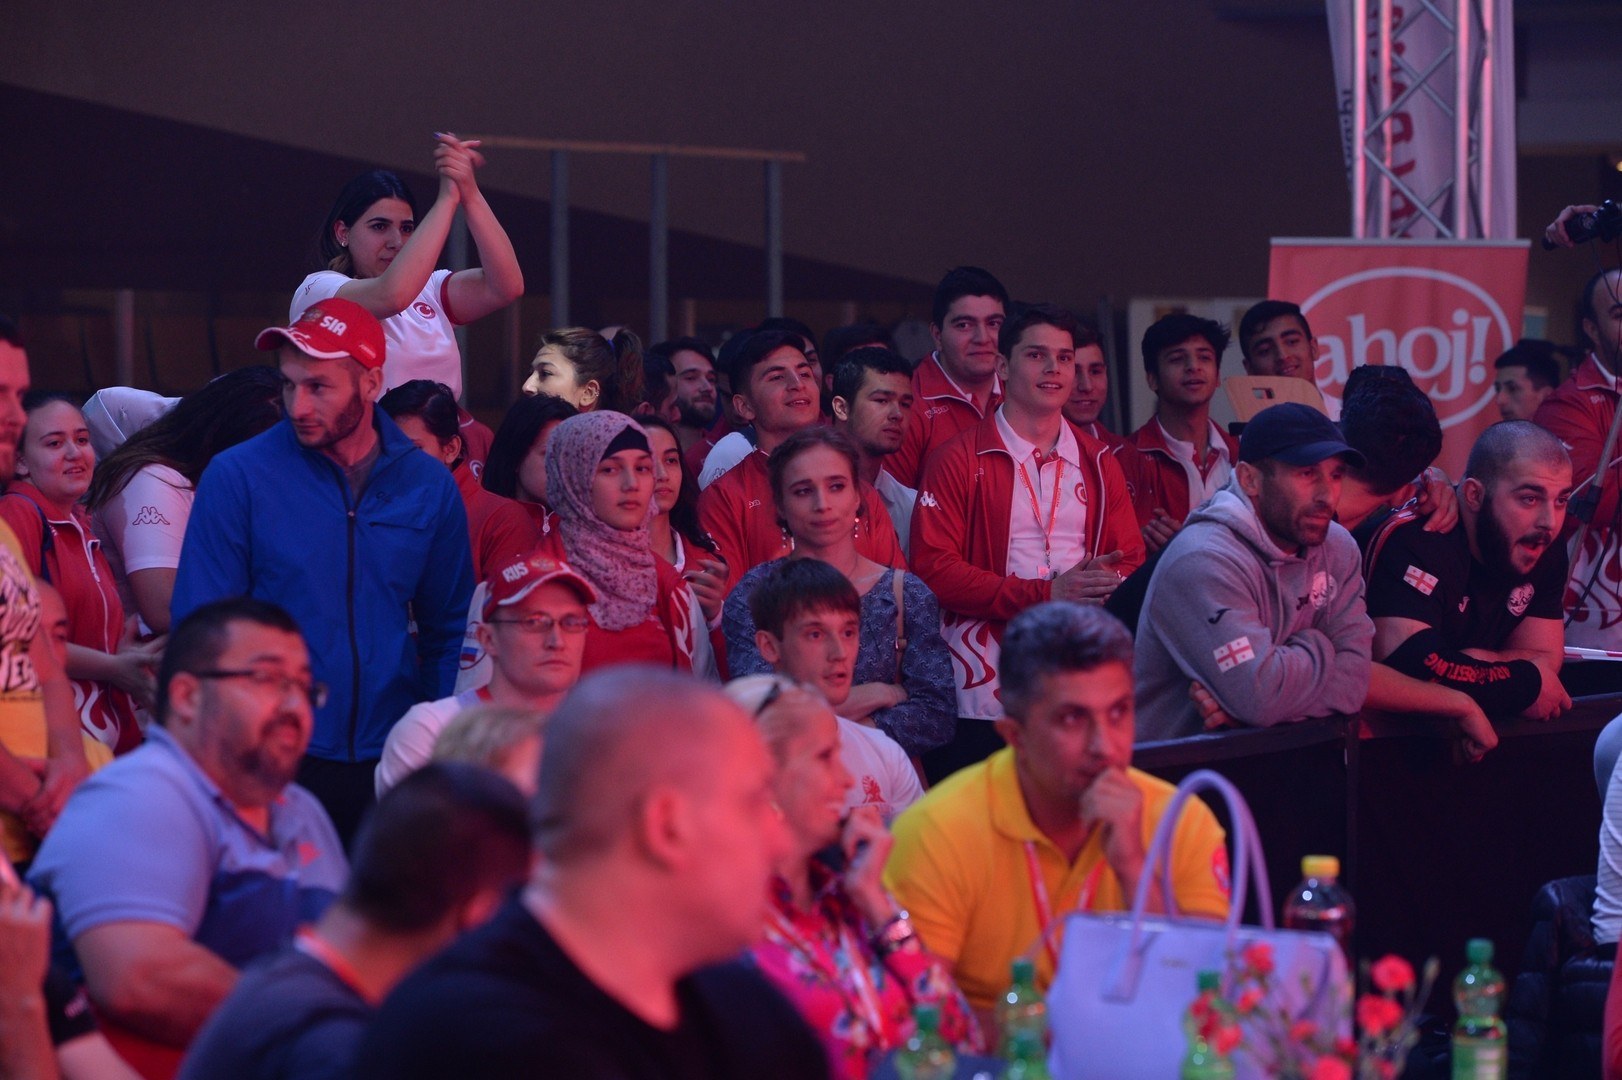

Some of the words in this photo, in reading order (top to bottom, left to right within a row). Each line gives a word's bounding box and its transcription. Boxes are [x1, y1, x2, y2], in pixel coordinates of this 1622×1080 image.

[319, 315, 348, 337] SIA
[1315, 308, 1493, 400] ahoj!
[502, 561, 529, 583] RUS
